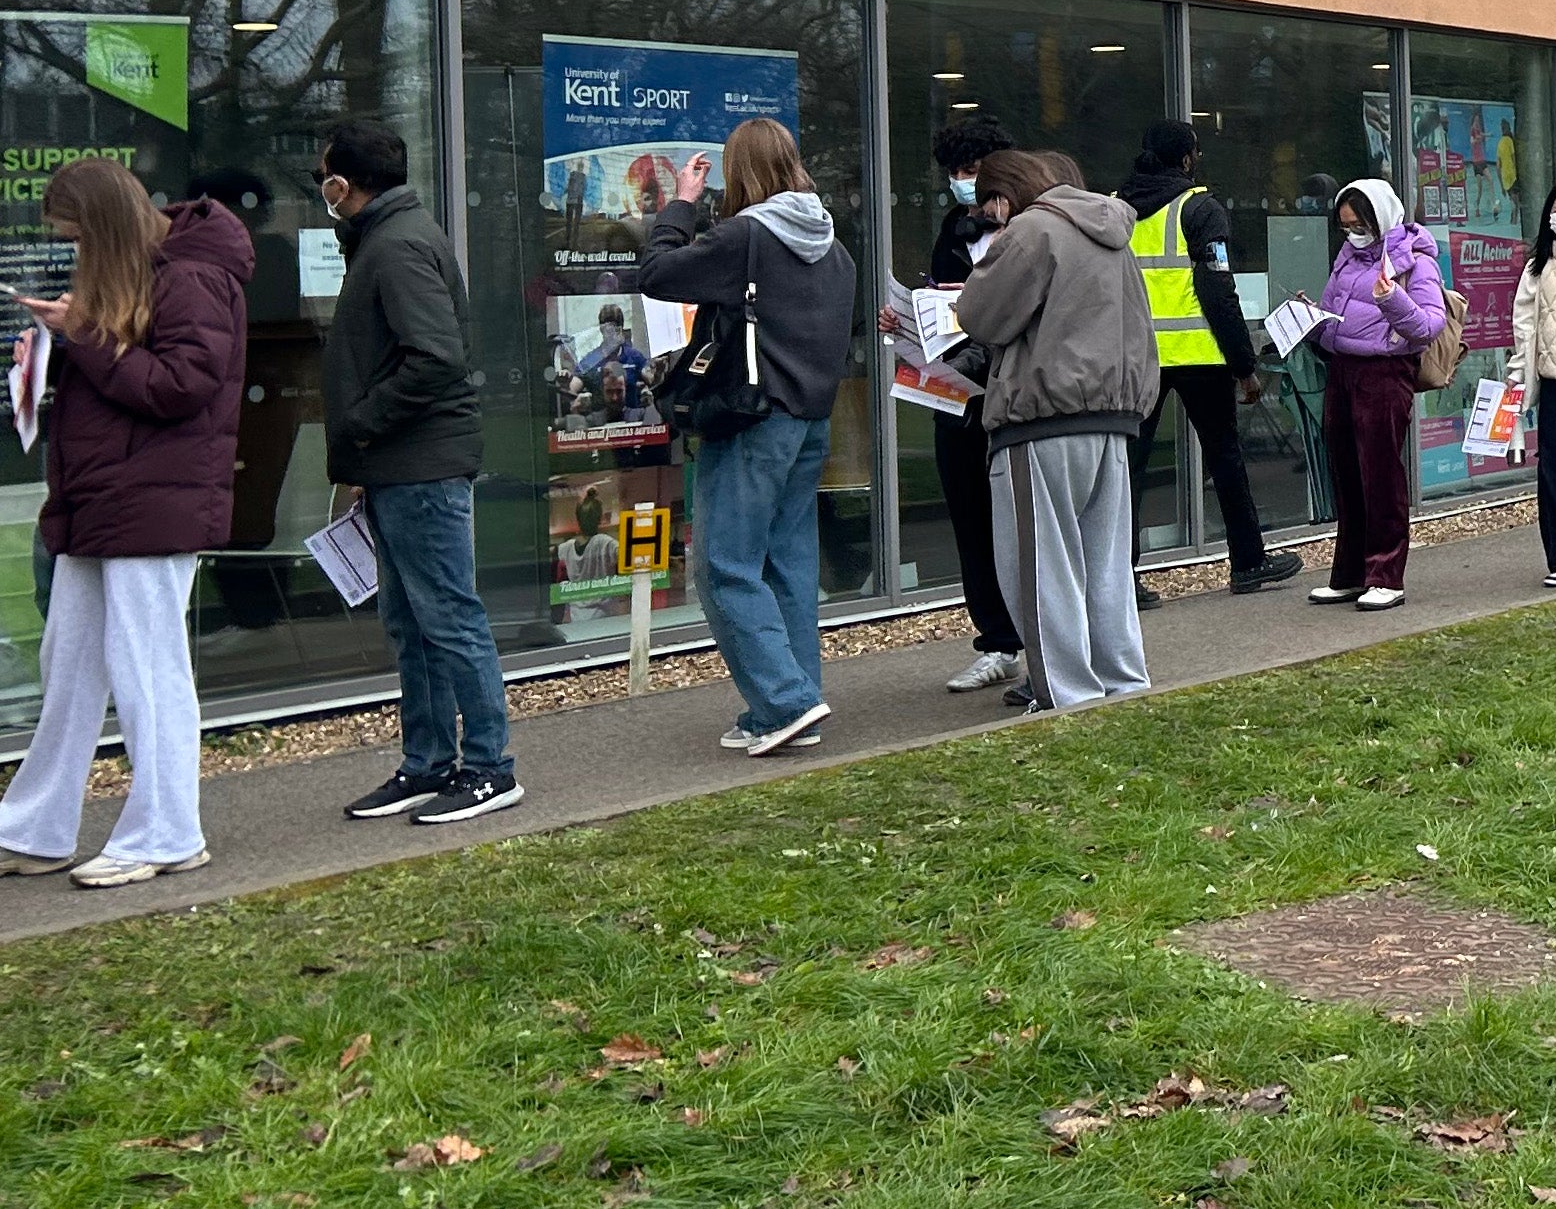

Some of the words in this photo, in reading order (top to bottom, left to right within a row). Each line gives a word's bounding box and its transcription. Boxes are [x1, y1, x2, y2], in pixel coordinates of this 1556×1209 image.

[112, 58, 160, 79] Kent
[564, 67, 609, 82] University
[609, 69, 620, 80] of
[565, 78, 621, 107] Kent
[633, 87, 691, 110] SPORT
[565, 113, 586, 123] More
[587, 114, 604, 124] than
[605, 117, 620, 126] you
[620, 116, 641, 127] might
[642, 117, 667, 126] expect
[0, 178, 49, 203] ICE
[608, 250, 636, 262] events
[1463, 244, 1480, 261] ALL
[1483, 241, 1513, 261] Active
[557, 429, 586, 442] Health
[587, 429, 605, 440] and
[634, 423, 666, 436] services
[624, 514, 663, 568] H
[560, 579, 591, 592] Fitness
[591, 576, 610, 589] and
